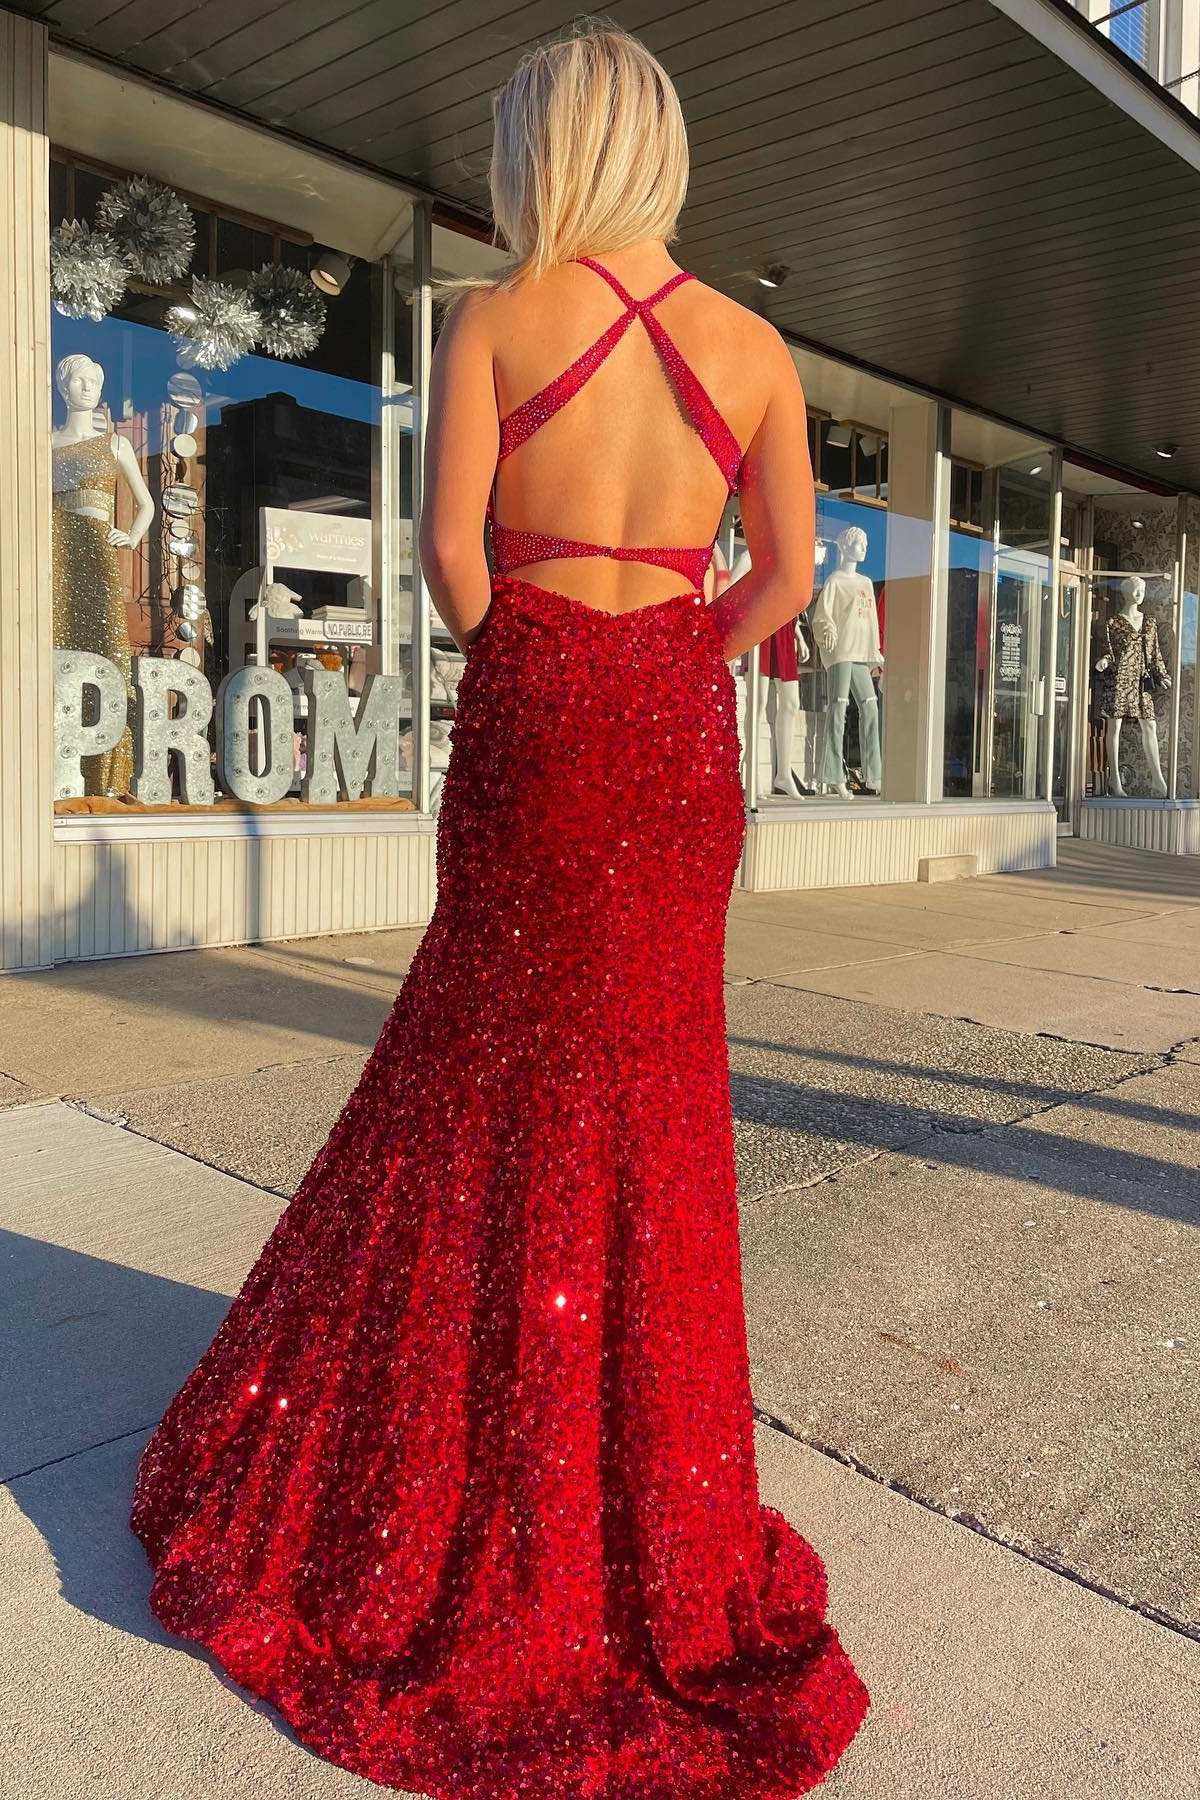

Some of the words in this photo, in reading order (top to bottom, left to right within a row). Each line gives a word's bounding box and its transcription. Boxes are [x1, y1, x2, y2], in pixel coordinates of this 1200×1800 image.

[328, 623, 338, 636] NO
[339, 623, 362, 637] PUBLIC
[53, 650, 400, 805] PROM
